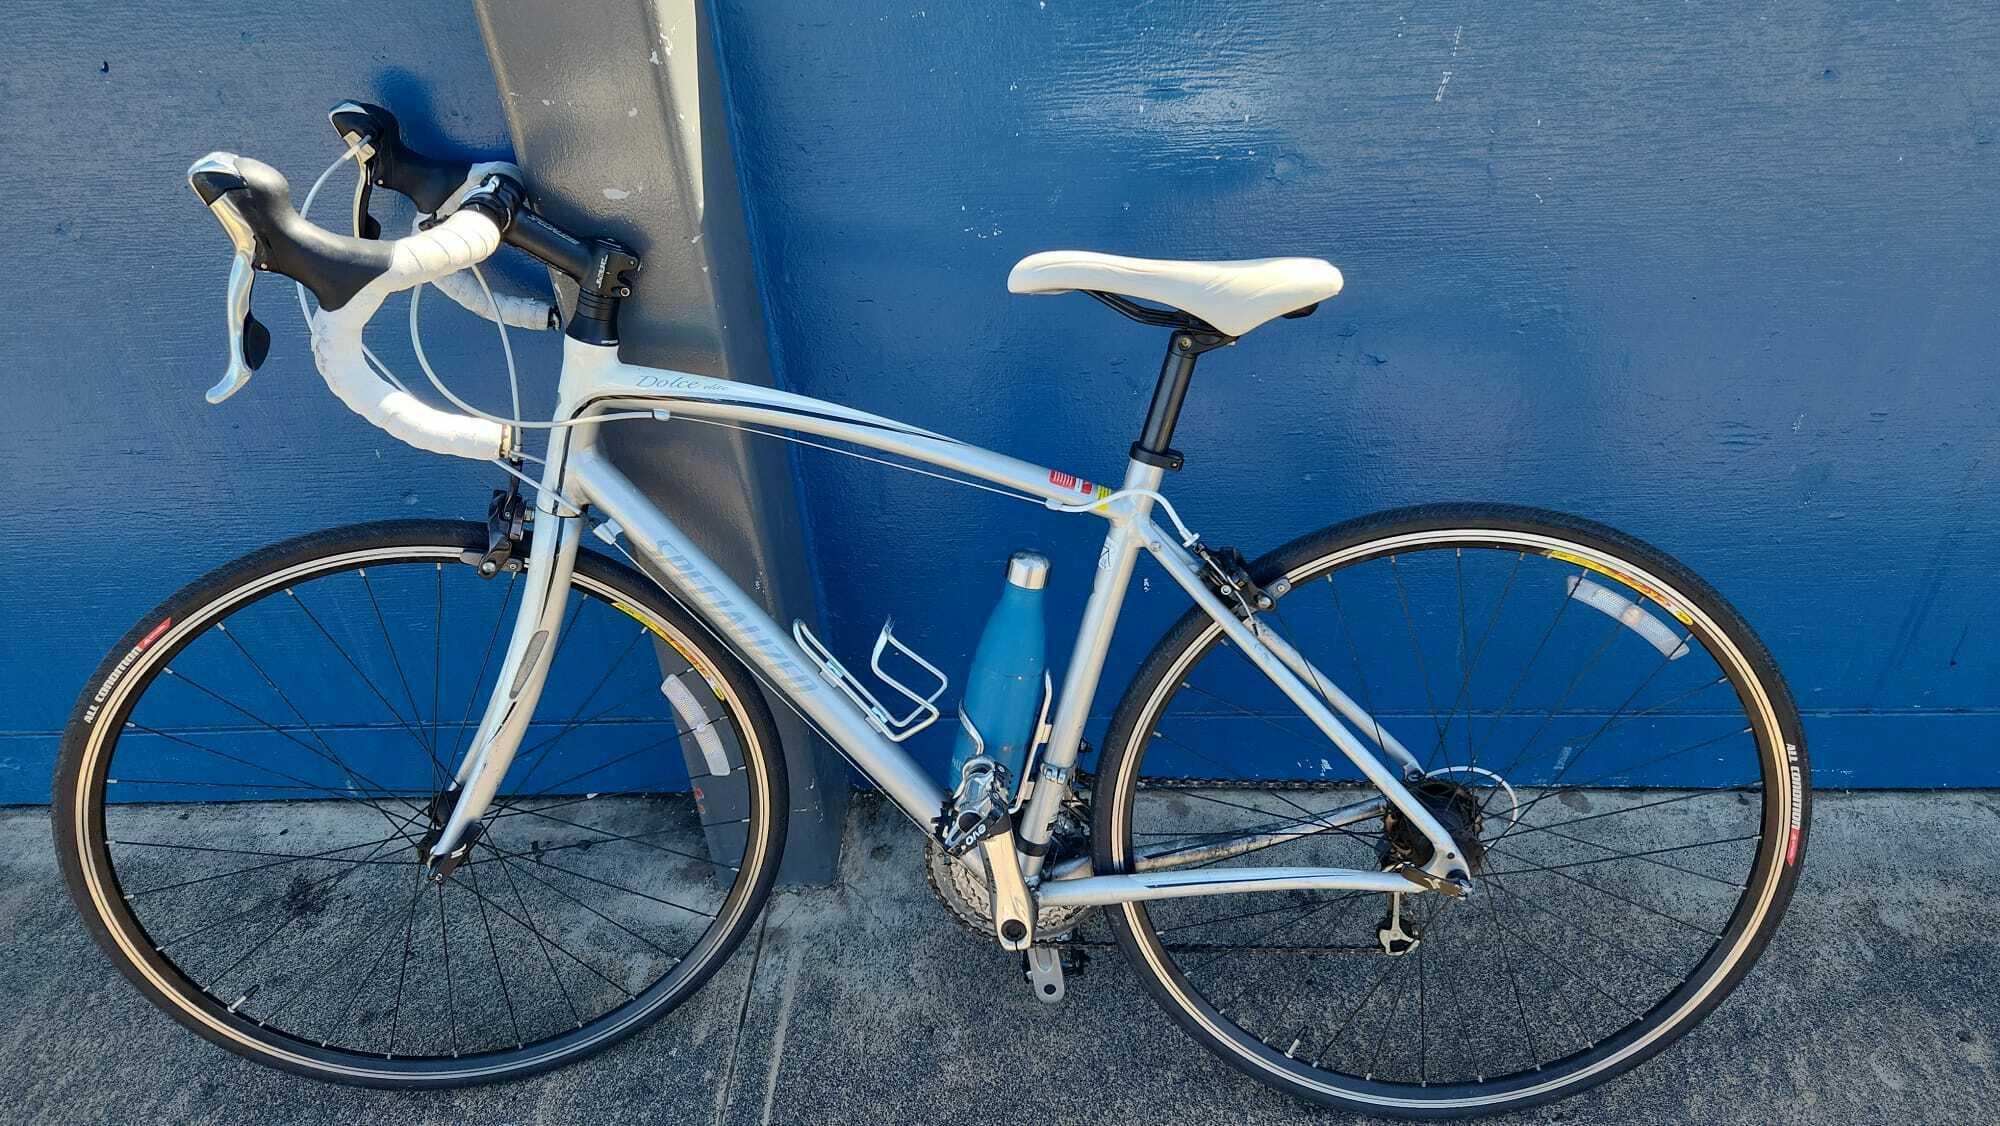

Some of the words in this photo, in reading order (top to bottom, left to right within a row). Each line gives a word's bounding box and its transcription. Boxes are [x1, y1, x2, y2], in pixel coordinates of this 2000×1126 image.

[636, 375, 699, 389] Dolce
[655, 538, 818, 693] SPECIALIZED
[83, 704, 100, 724] ALL
[1786, 743, 1799, 763] ALL
